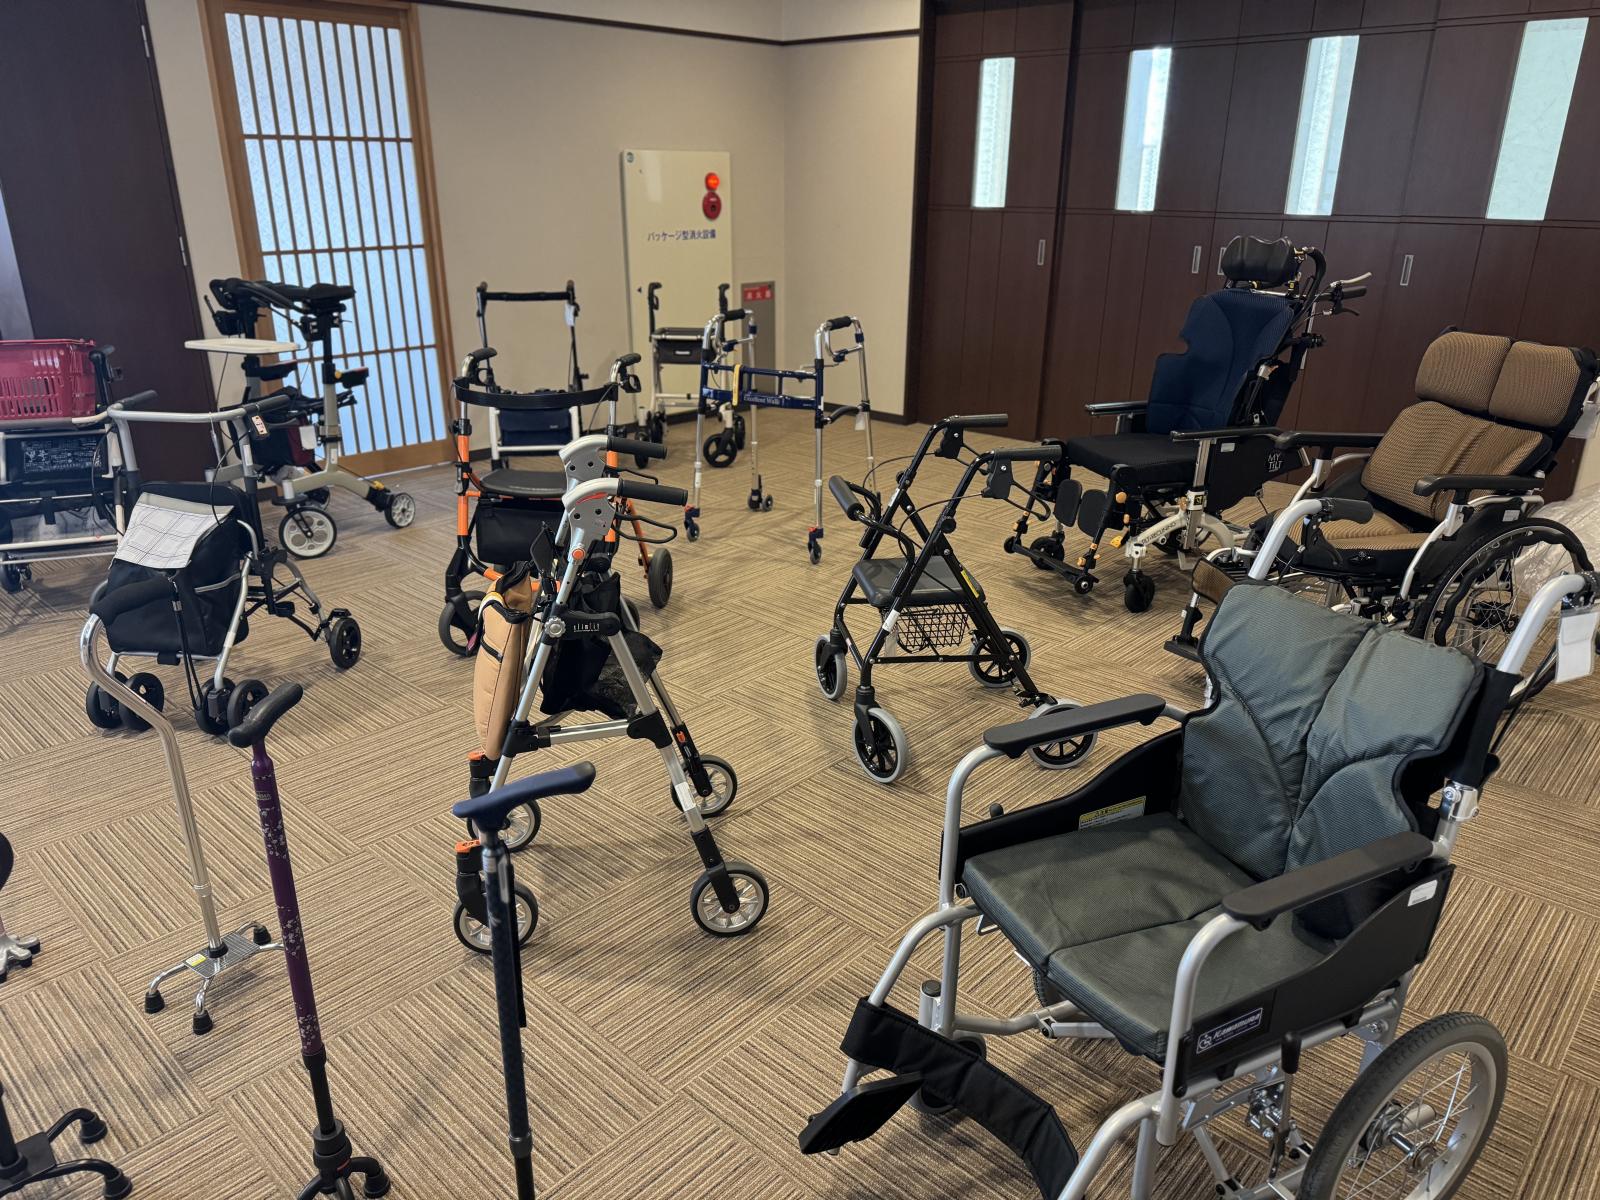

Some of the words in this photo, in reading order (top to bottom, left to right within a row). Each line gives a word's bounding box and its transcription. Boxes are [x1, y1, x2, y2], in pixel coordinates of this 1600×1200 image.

[648, 229, 717, 242] パッケージ型消火設備
[1268, 453, 1280, 462] MY
[1269, 461, 1283, 470] TILT
